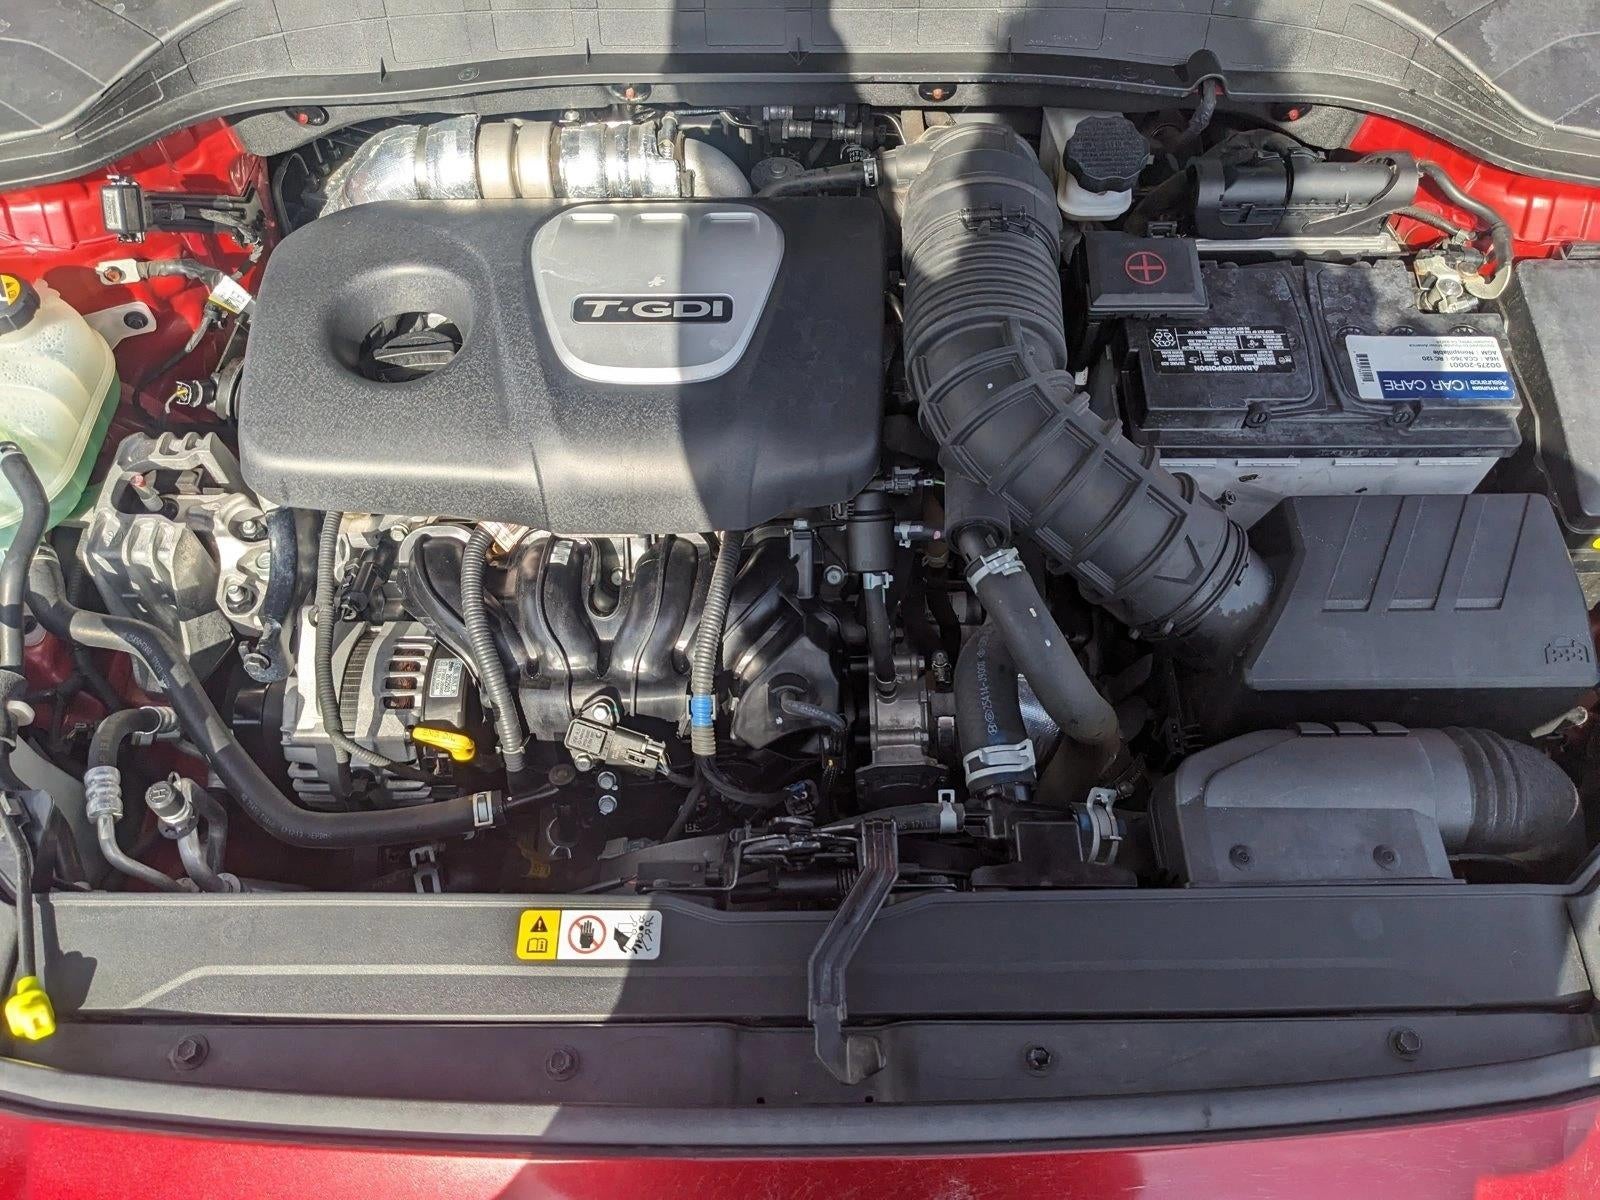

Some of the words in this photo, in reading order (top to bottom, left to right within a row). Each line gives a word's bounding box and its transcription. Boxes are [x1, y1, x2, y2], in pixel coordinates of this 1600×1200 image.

[583, 300, 723, 318] T-GDI
[1383, 379, 1427, 391] CARE
[1430, 379, 1464, 391] CAR
